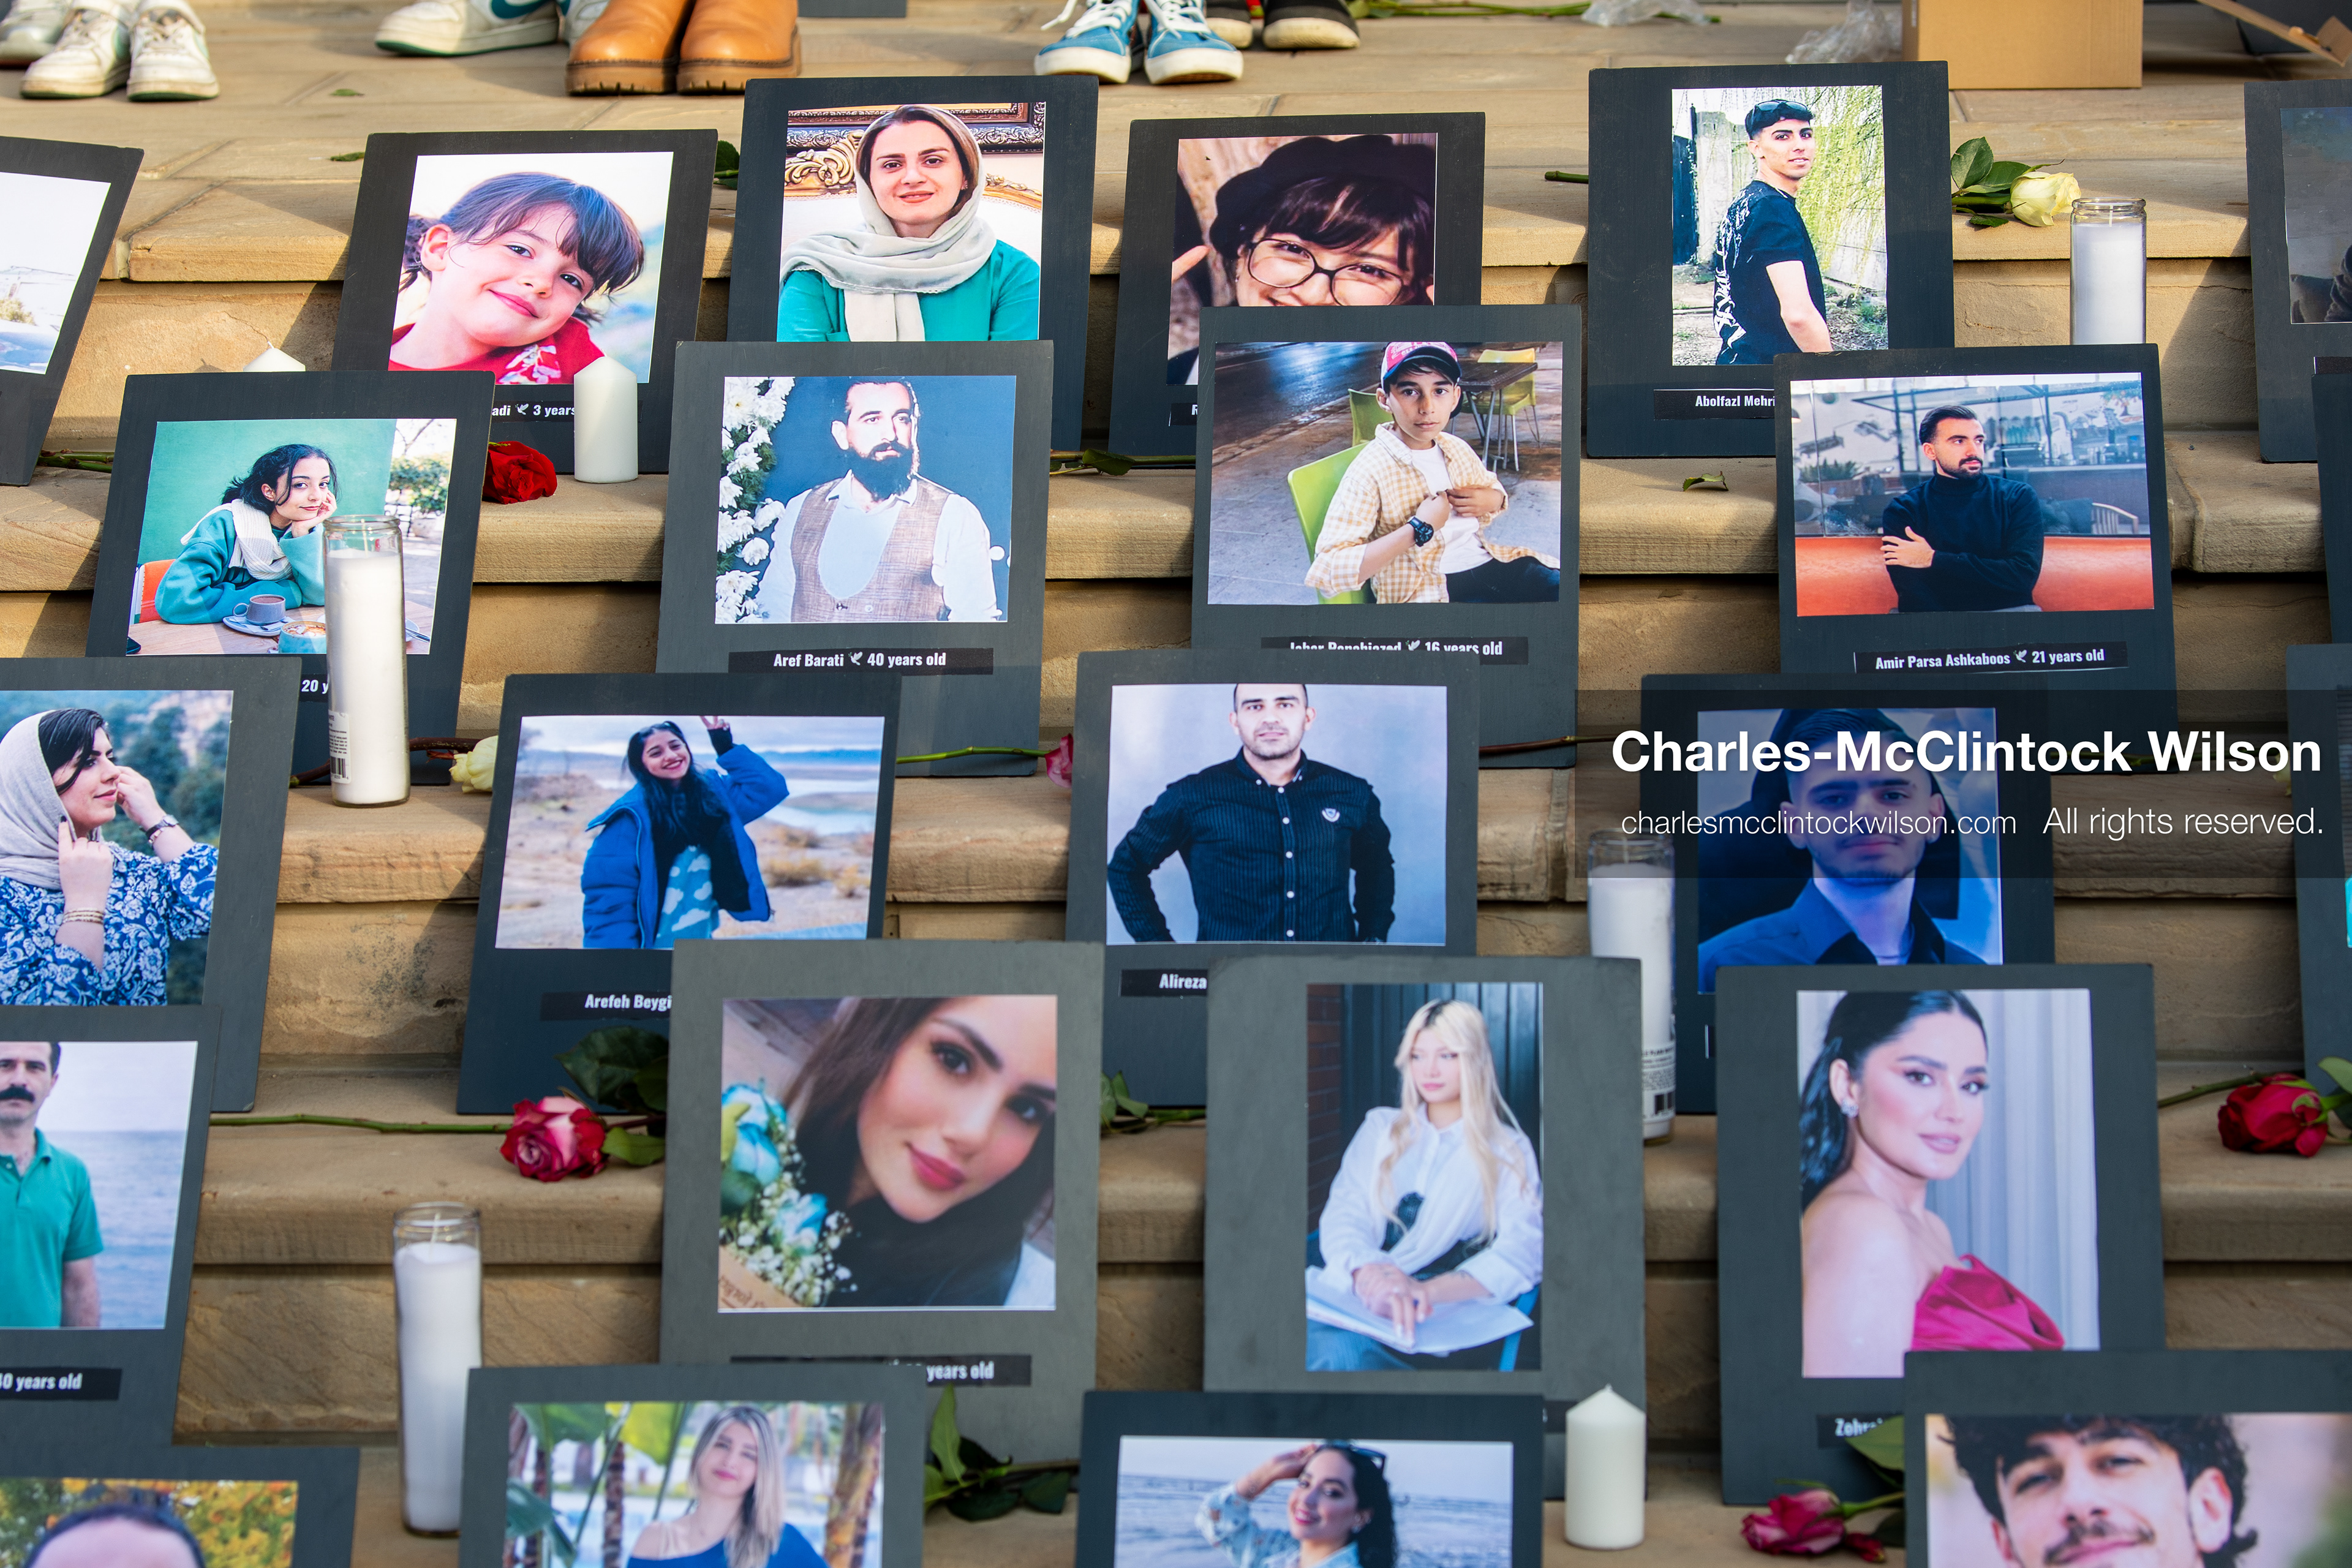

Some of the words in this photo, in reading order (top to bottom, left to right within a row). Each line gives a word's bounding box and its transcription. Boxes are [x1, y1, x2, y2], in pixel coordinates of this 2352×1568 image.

[1695, 395, 1740, 407] Abolfazl
[533, 405, 541, 415] 3
[545, 407, 575, 417] years
[1425, 642, 1440, 651] 16
[1482, 641, 1502, 655] old
[774, 654, 801, 667] Aref
[804, 654, 844, 667] Barati
[867, 653, 884, 666] 40
[888, 656, 922, 668] years
[926, 652, 946, 666] old
[1875, 657, 1905, 669] Amir
[1908, 655, 1942, 668] Parsa
[1945, 653, 2011, 666] Ashkaboos
[2032, 650, 2046, 663] 21
[2049, 652, 2083, 665] years
[2086, 649, 2105, 662] old
[301, 679, 318, 692] 20
[1159, 973, 1208, 989] Alireza
[584, 993, 630, 1009] Arefeh
[633, 994, 673, 1011] Beygi
[926, 1365, 967, 1382] years
[970, 1360, 995, 1379] old
[15, 1376, 56, 1392] years
[58, 1372, 83, 1390] old
